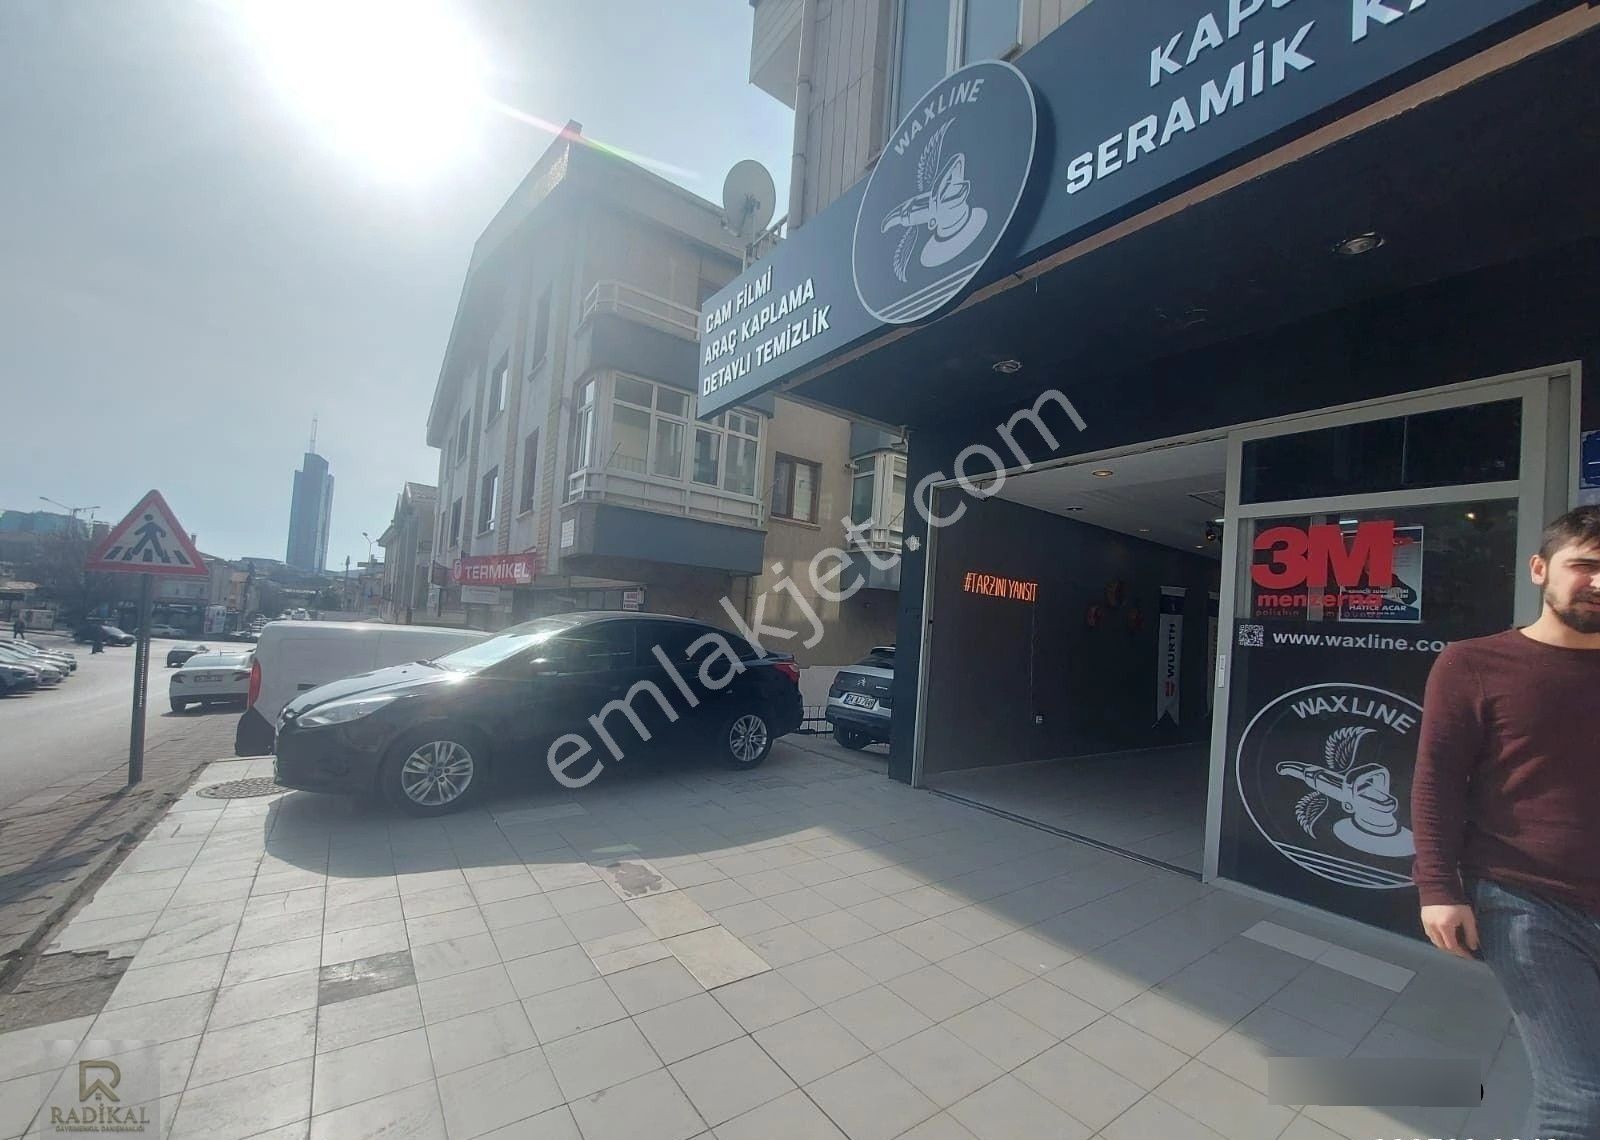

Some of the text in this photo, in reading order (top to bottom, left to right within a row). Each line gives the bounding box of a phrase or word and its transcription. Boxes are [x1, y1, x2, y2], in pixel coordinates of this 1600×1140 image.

[1150, 0, 1294, 87] KAP
[894, 79, 984, 155] WAXLINE
[1066, 20, 1316, 194] SERAMİK
[704, 278, 815, 365] ARAÇ KAPLAMA
[706, 265, 773, 333] CAM FİLMİ
[703, 304, 831, 396] DETAYLI TEMİZLİK
[464, 560, 529, 580] TERMİKEL
[1251, 520, 1394, 589] 3M
[1273, 632, 1450, 652] www.waxline.co
[1291, 696, 1416, 734] WAXLINE
